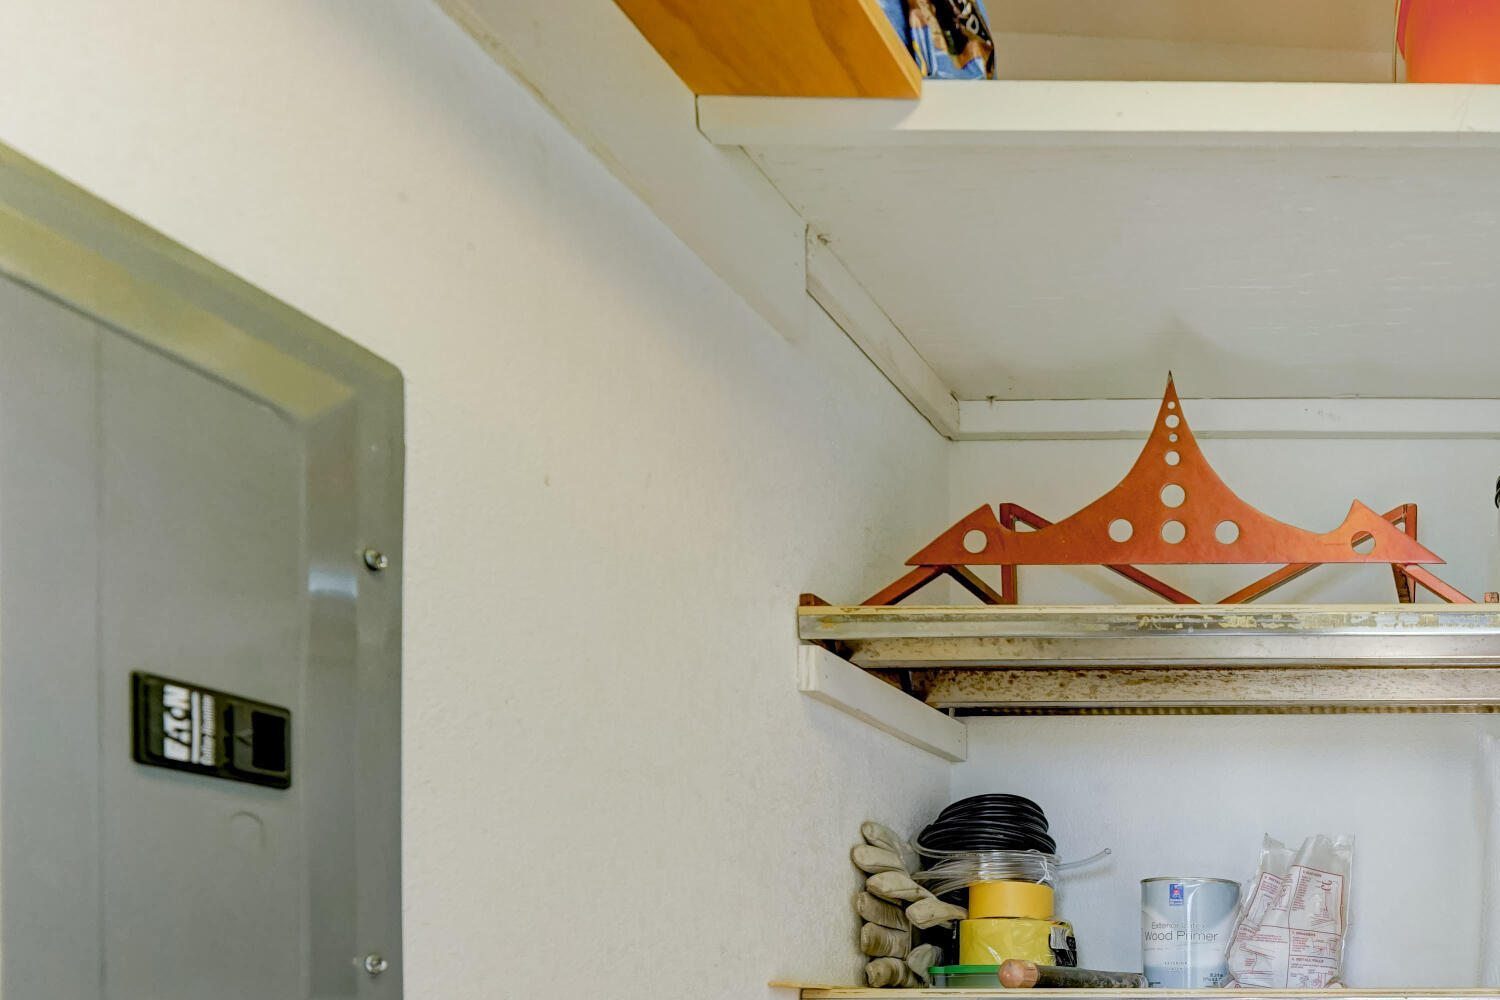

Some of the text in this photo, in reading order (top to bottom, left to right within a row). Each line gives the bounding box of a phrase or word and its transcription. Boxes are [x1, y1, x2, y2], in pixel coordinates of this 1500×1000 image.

[163, 683, 191, 762] EATON
[1145, 931, 1218, 941] Wood Primer
